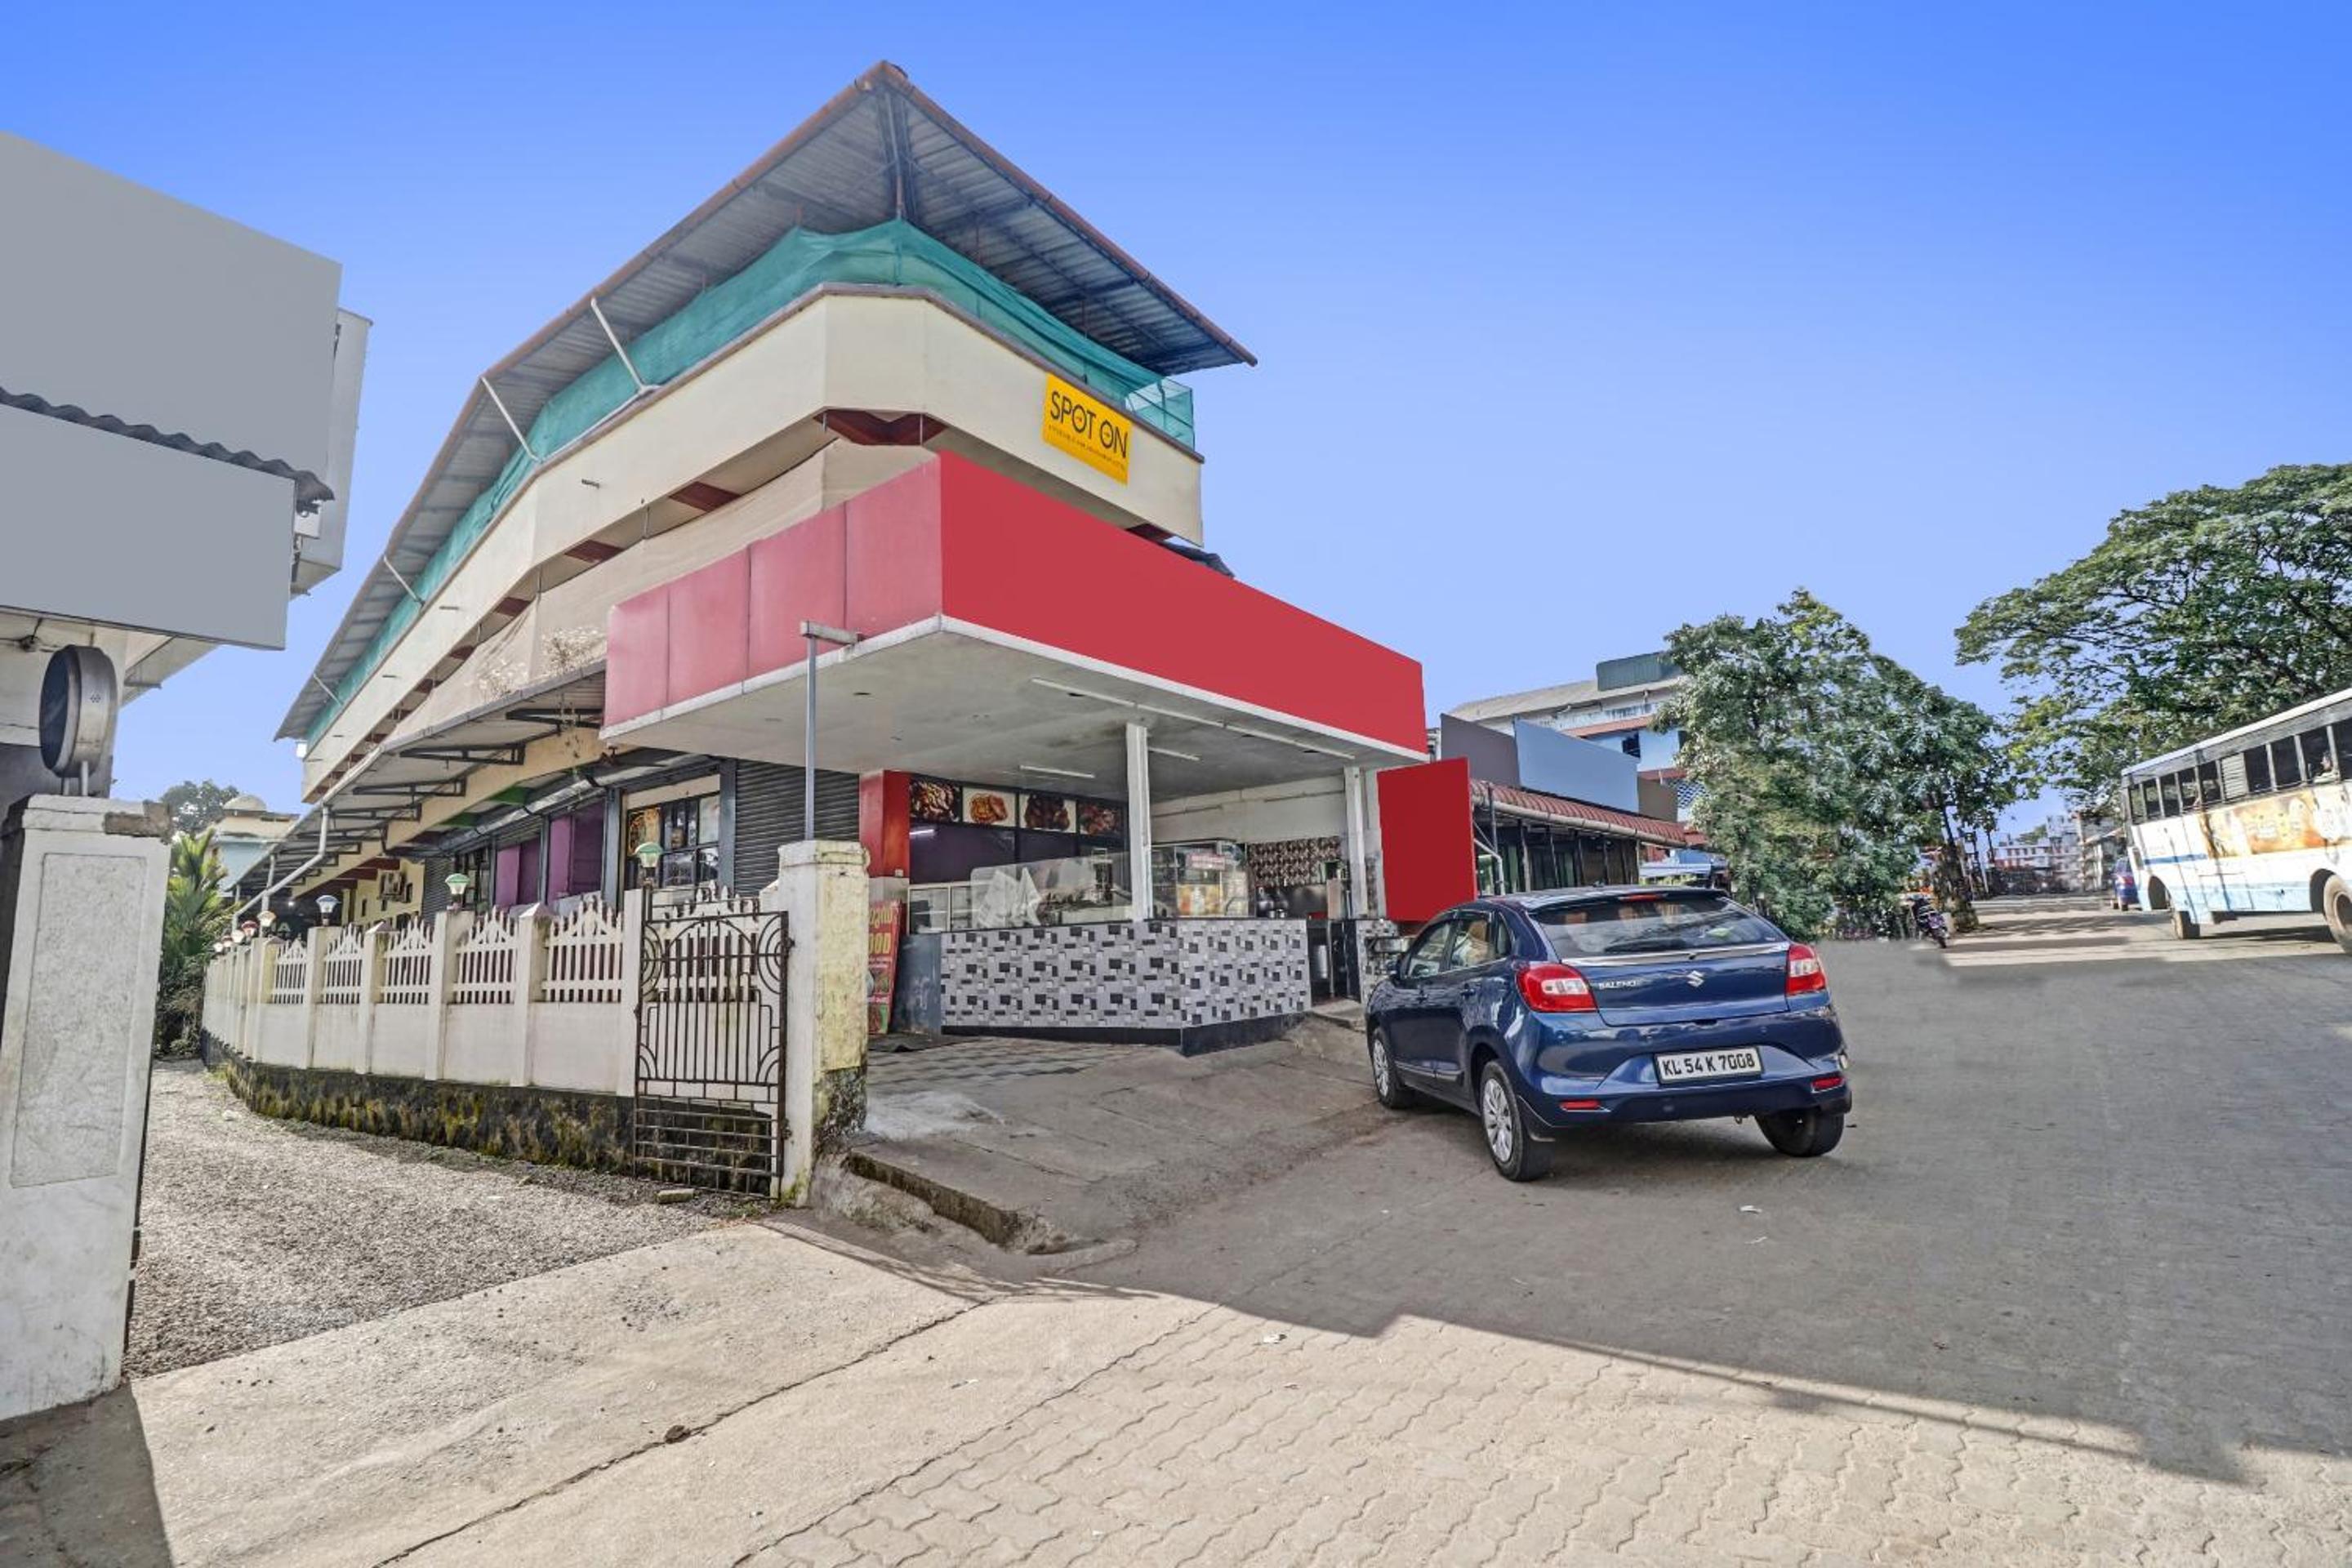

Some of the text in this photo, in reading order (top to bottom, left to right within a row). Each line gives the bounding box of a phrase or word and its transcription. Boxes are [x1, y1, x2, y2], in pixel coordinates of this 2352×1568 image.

[1050, 390, 1096, 439] SPOT
[1099, 419, 1128, 459] ON
[869, 933, 891, 954] OOD
[1662, 1060, 1682, 1076] KL
[1684, 1058, 1704, 1073] 54
[1705, 1056, 1716, 1071] K
